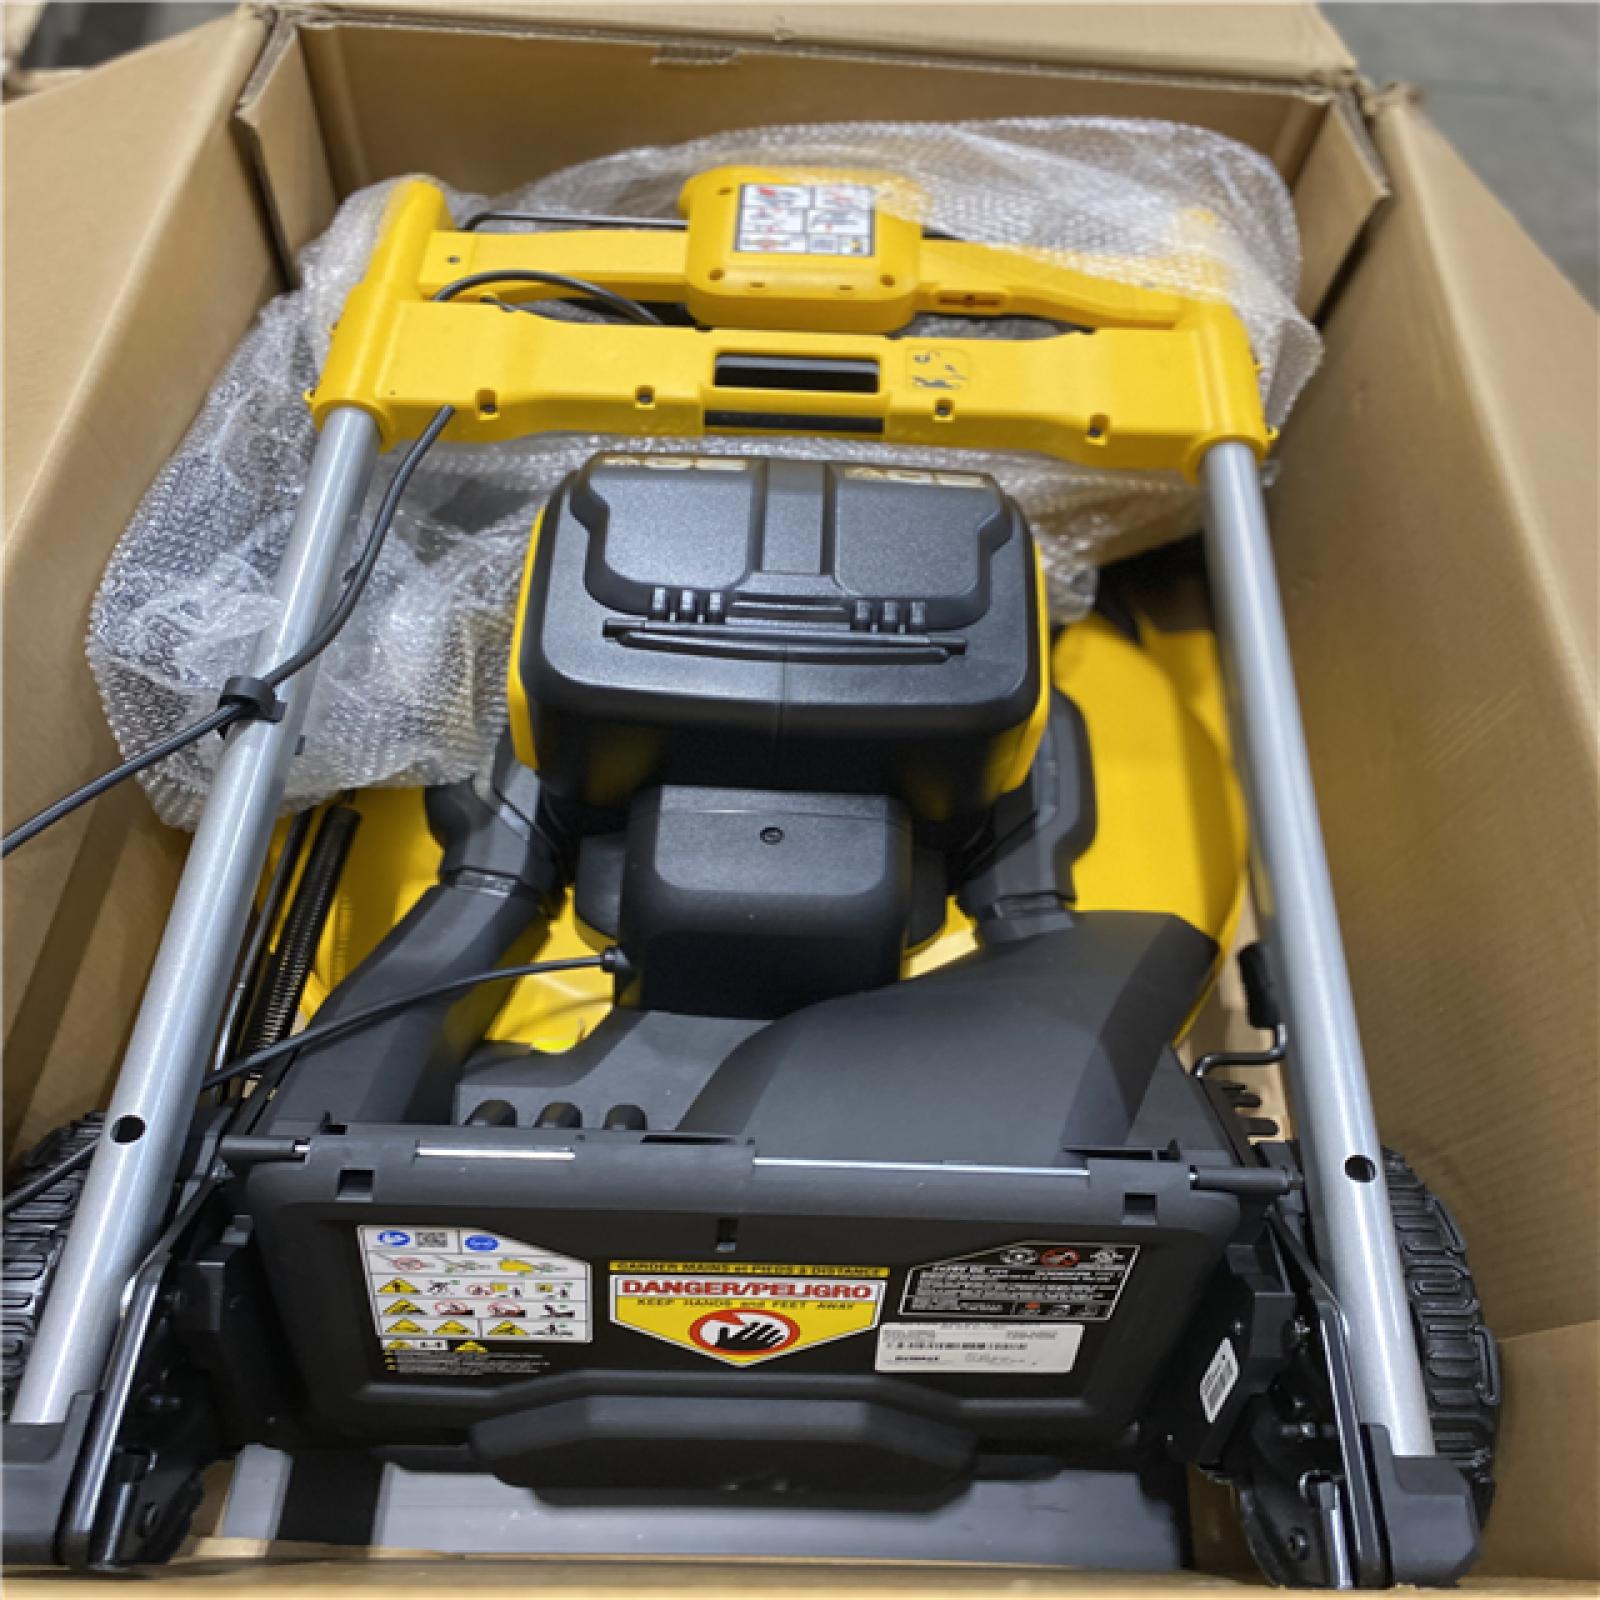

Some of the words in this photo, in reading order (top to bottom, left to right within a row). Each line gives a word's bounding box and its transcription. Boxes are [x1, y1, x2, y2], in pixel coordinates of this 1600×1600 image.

[616, 1262, 678, 1271] GARDER
[682, 1263, 728, 1272] MAINS
[812, 1265, 880, 1276] DISTANCE
[623, 1279, 872, 1297] DANGER/PELIGRO
[637, 1297, 674, 1306] KEEP
[684, 1298, 731, 1307] HANDS
[772, 1300, 806, 1309] FEET
[816, 1301, 853, 1310] AWAY
